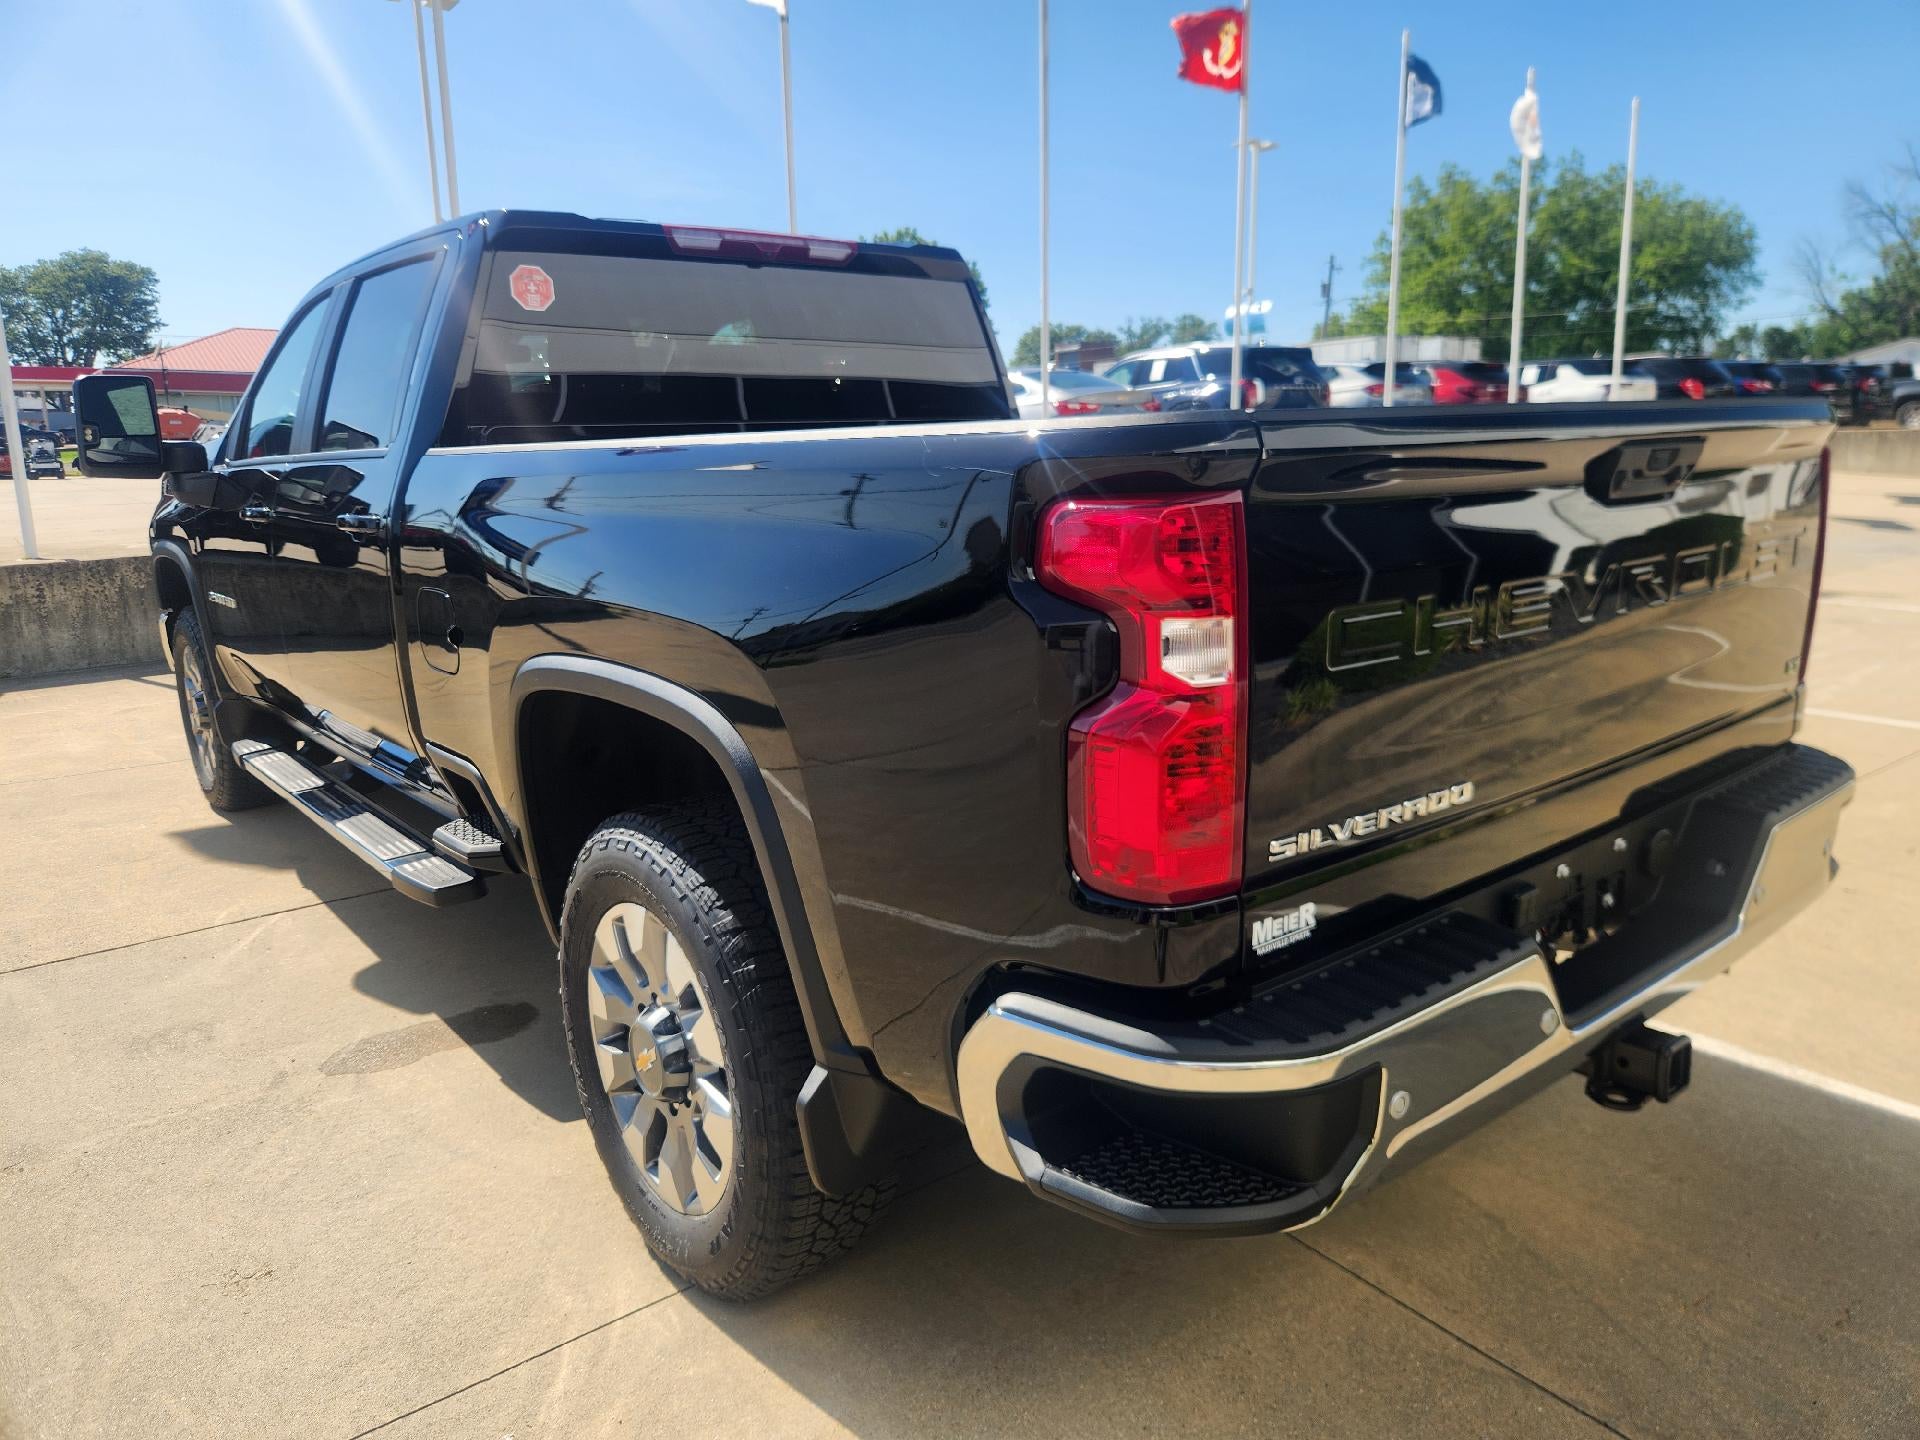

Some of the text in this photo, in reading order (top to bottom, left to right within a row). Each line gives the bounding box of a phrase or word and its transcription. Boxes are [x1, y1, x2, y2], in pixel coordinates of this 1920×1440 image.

[1327, 525, 1806, 671] CHEVROLET
[1268, 781, 1474, 862] SILVERADO
[1252, 902, 1317, 947] MEIER
